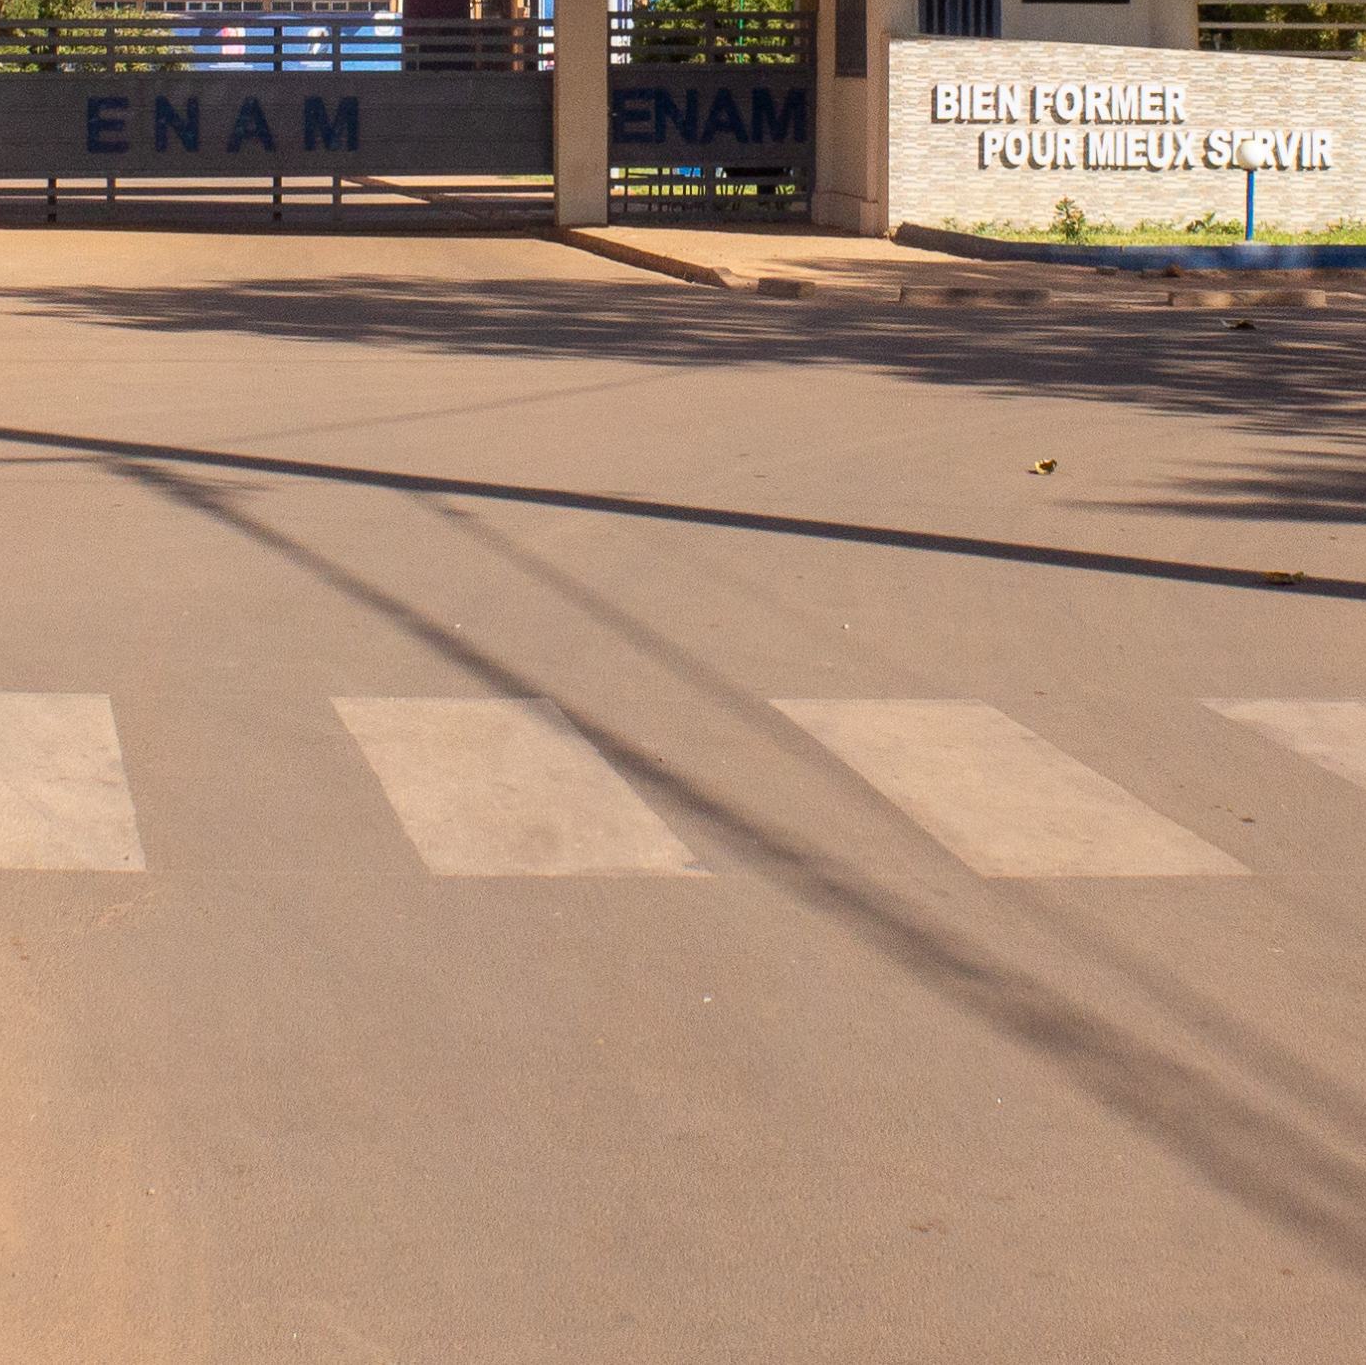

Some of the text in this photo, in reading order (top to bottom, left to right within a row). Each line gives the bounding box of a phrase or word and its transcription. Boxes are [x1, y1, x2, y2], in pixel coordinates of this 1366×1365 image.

[86, 95, 360, 154] ENAM
[611, 87, 807, 144] ENAM
[936, 84, 1187, 122] BIEN FORMER
[982, 130, 1078, 167] POUR
[1088, 130, 1195, 168] MIEUX
